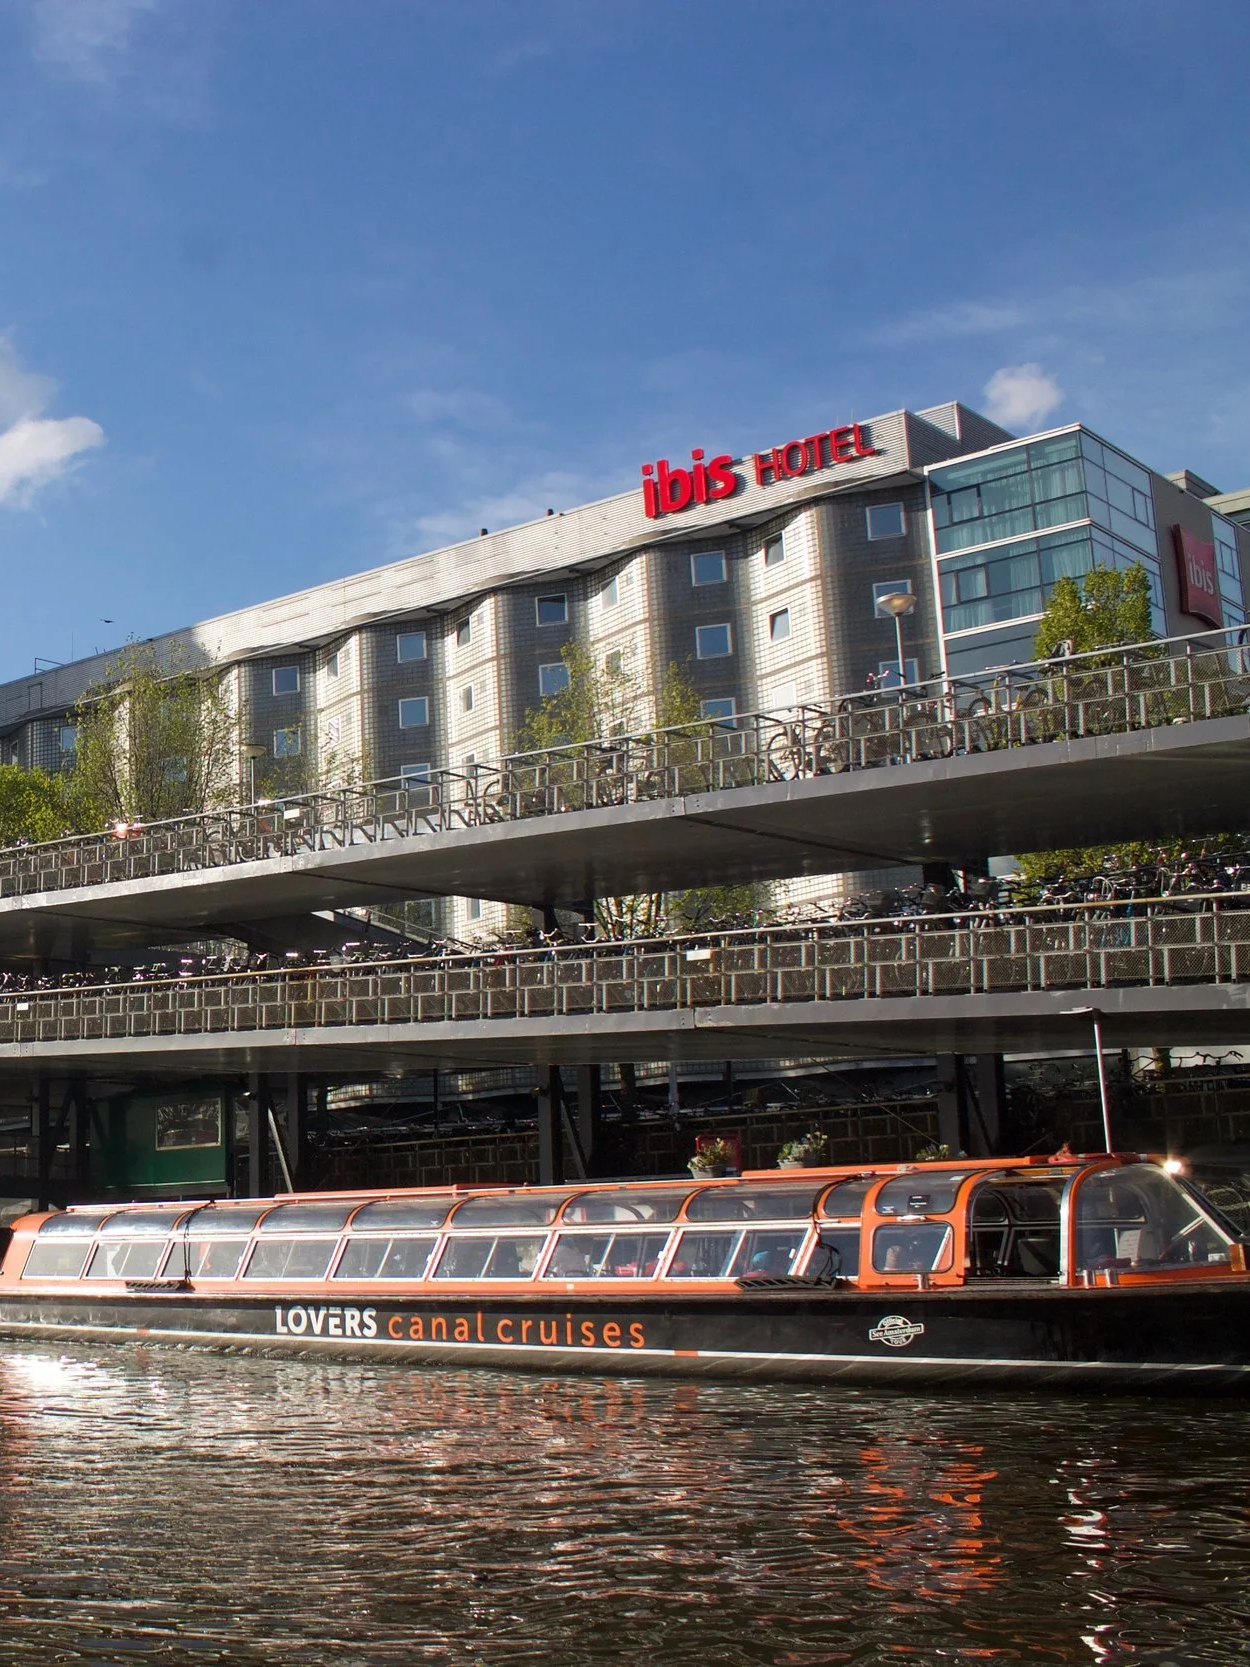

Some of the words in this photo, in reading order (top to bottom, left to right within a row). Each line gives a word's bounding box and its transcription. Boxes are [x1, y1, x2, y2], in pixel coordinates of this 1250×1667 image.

[641, 448, 738, 519] ibis
[754, 423, 875, 487] HOTEL
[1188, 552, 1214, 595] ibis
[275, 1306, 378, 1338] LOVERS
[388, 1311, 485, 1342] canal
[496, 1313, 646, 1349] cruises
[872, 1330, 884, 1338] See
[884, 1326, 921, 1336] Amsterdam
